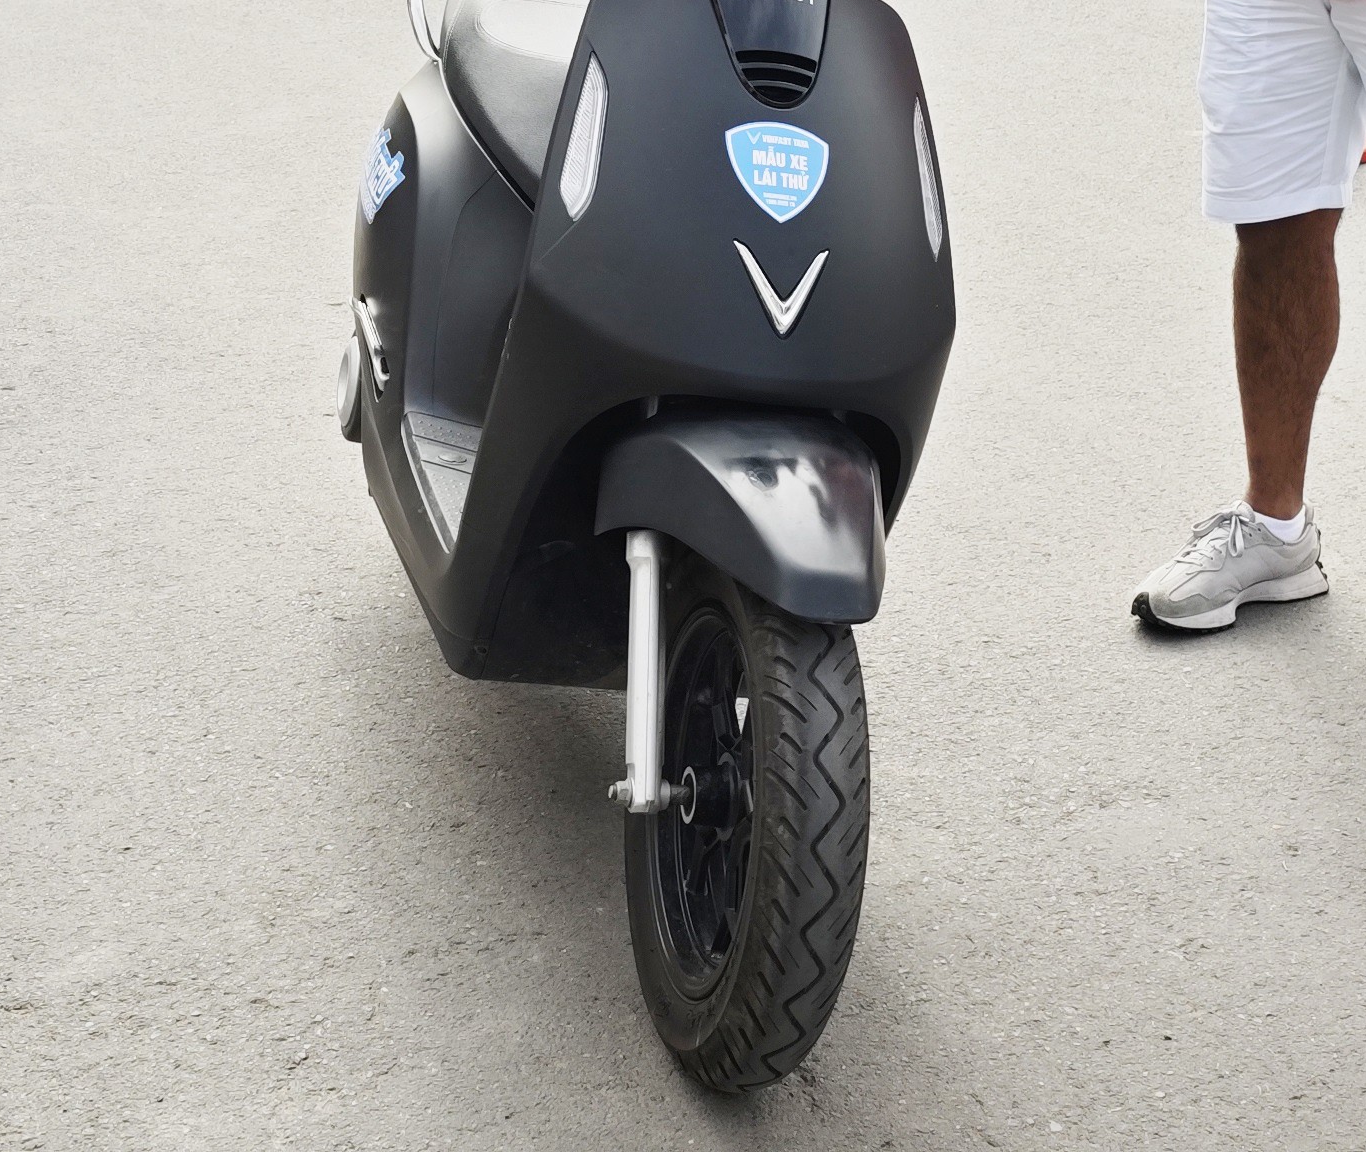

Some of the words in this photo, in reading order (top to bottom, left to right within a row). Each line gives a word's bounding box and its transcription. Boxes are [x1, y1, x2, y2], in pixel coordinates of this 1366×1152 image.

[752, 145, 786, 167] MẪU
[789, 153, 809, 171] XE
[753, 168, 777, 186] LÁI
[780, 170, 809, 191] THỬ
